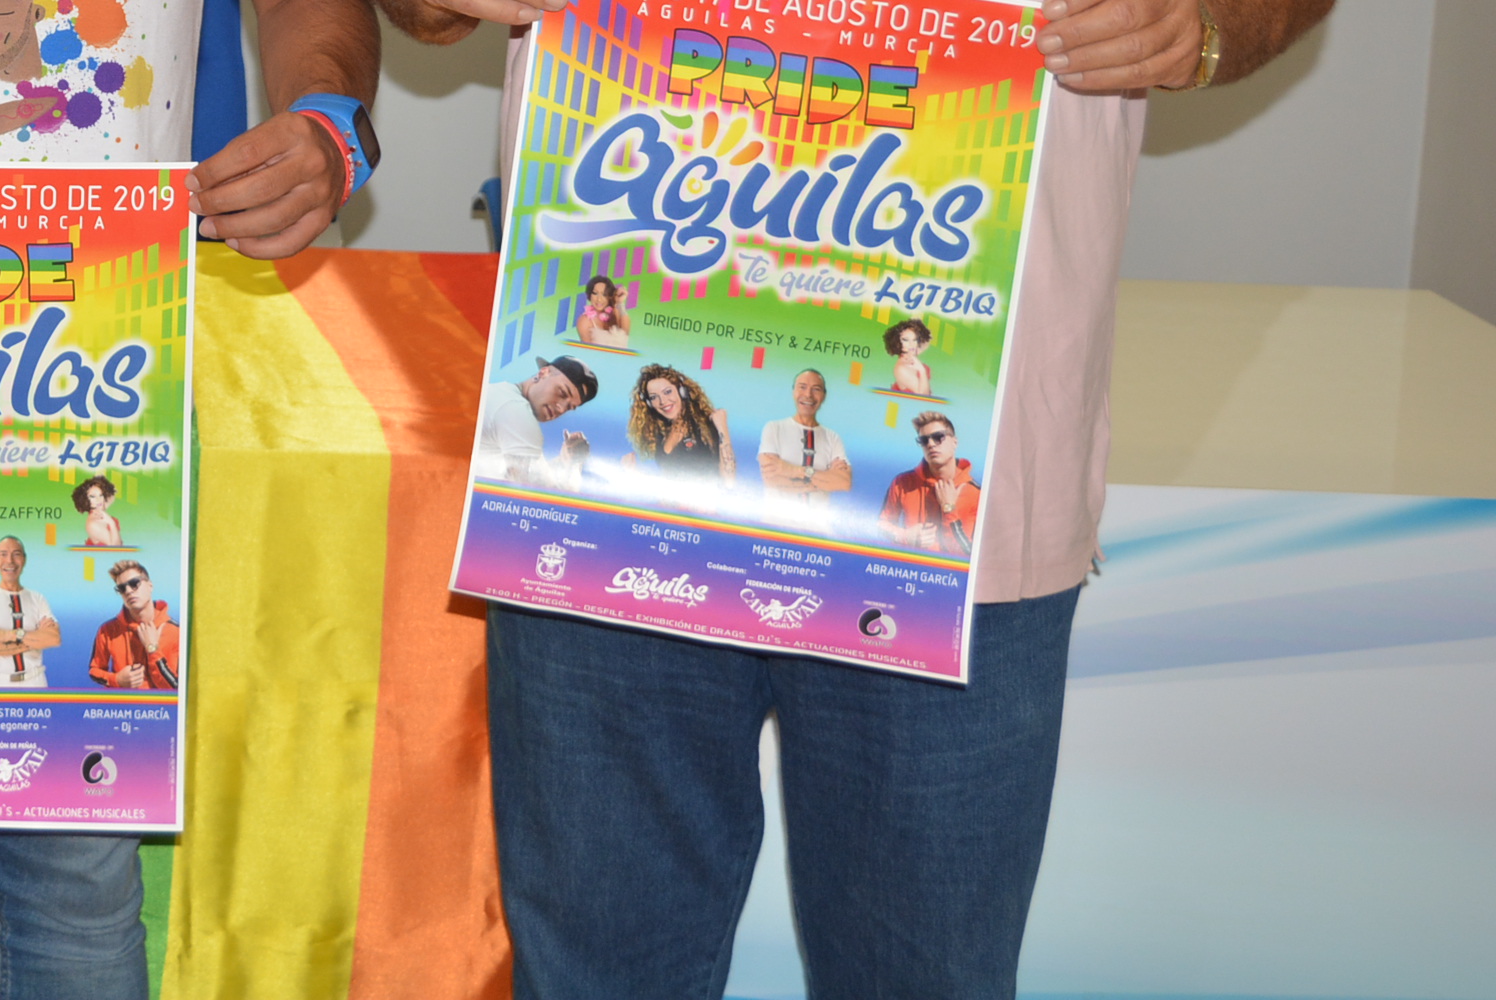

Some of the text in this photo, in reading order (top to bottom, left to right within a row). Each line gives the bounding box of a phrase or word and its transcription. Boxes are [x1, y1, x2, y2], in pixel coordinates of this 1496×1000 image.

[919, 8, 959, 39] DE
[968, 16, 1038, 51] 2019
[838, 29, 957, 58] MURCIA
[667, 28, 918, 130] PRIDE
[68, 185, 102, 211] DE
[114, 186, 175, 211] 2019
[735, 252, 997, 321] Te quiere LGTBIQ
[643, 311, 871, 359] DIRIGIDO POR JESSY & ZAFFYRO
[58, 440, 170, 468] LGTBIQ
[0, 507, 62, 520] ZAFFYRO
[482, 500, 579, 524] ADRIÁN RODRÍGUEZ
[519, 518, 531, 532] Dj
[632, 522, 701, 544] SOFÍA CRISTO
[562, 537, 598, 549] Organiza:
[658, 540, 670, 554] Dj
[751, 543, 832, 567] MAESTRO JOAO
[706, 560, 748, 574] Colaboran:
[762, 558, 818, 579] Pregonero
[865, 562, 960, 587] ABRAHAM GARCÍA
[905, 582, 917, 595] Dj
[486, 586, 510, 598] 21:00
[532, 594, 572, 608] PREGÓN
[584, 604, 624, 617] DESFILE
[636, 614, 691, 630] EXHIBICIÓN
[694, 624, 707, 633] DE
[710, 627, 746, 639] DRAGS
[794, 640, 865, 658] ACTUACIONES
[868, 653, 926, 669] MUSICALES
[26, 708, 52, 718] JOAO
[83, 708, 170, 720] ABRAHAM GARCÍA
[122, 722, 132, 733] Dj
[24, 806, 90, 818] ACTUACIONES
[92, 808, 146, 819] MUSICALES
